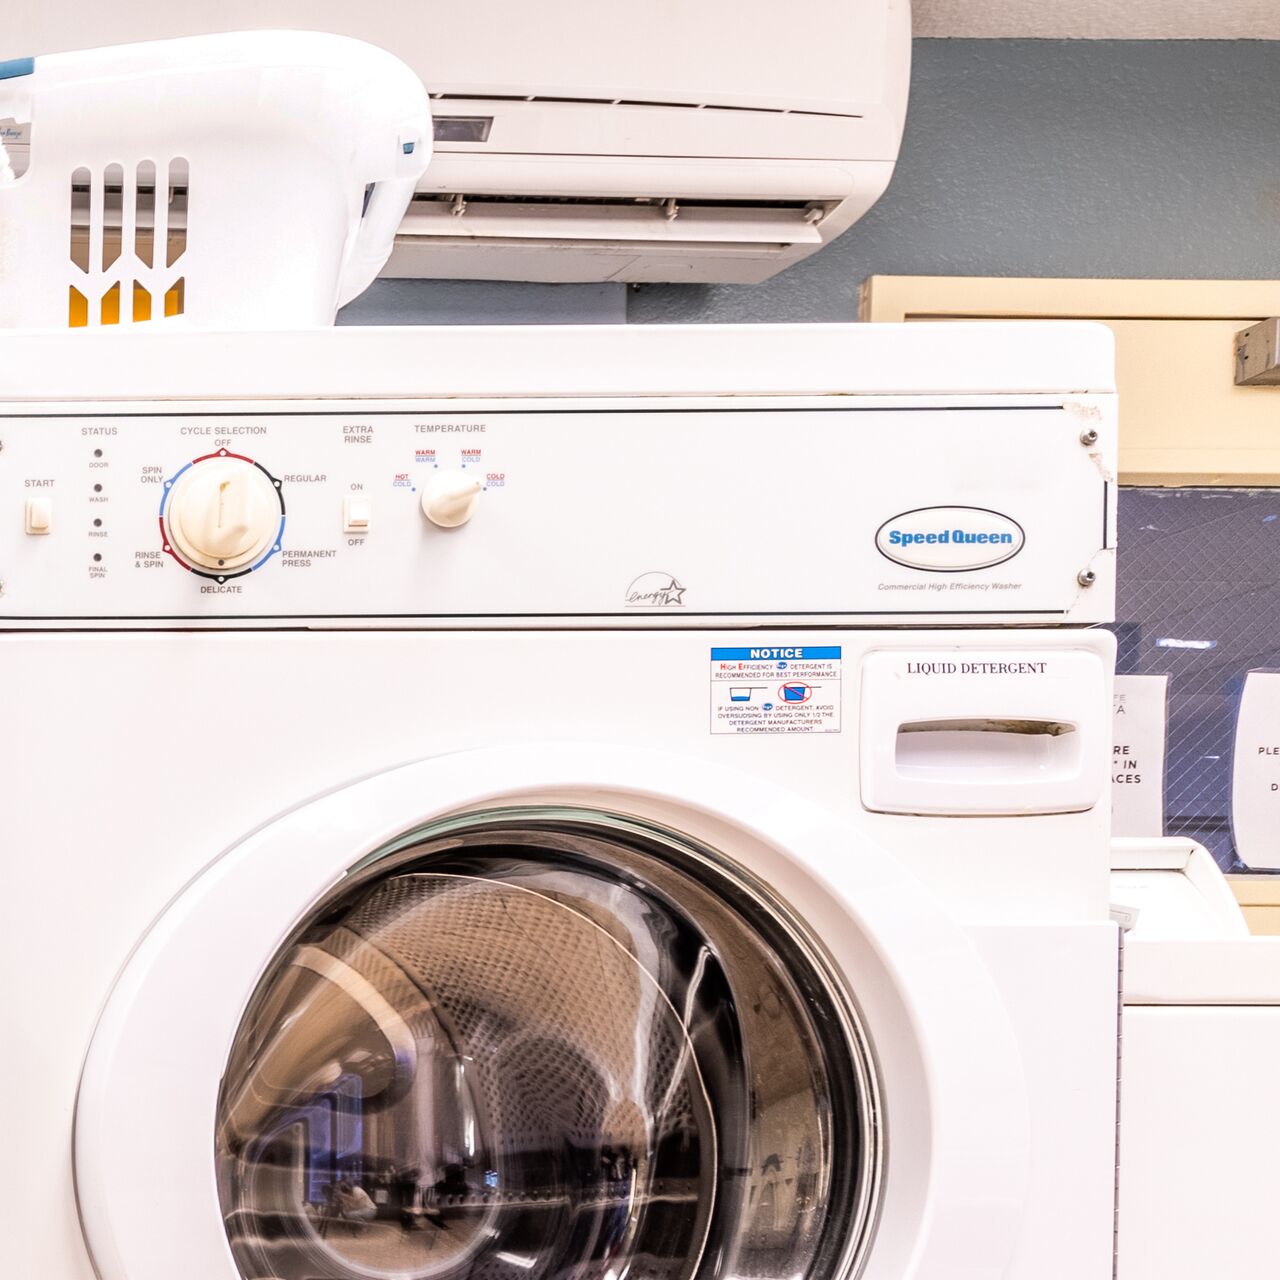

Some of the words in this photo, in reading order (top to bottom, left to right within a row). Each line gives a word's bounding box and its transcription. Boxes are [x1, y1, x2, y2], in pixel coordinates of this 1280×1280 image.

[81, 427, 117, 436] STATUS
[180, 427, 211, 435] CYCLE
[215, 426, 267, 435] SELECTION
[343, 426, 374, 434] EXTRA
[214, 439, 231, 447] OFF
[344, 435, 372, 443] RINSE
[141, 475, 163, 483] ONLY
[350, 483, 363, 491] ON
[348, 538, 364, 546] OFF
[889, 530, 949, 547] Speed
[952, 530, 1012, 544] Queen
[135, 551, 160, 559] RINSE
[282, 550, 336, 558] PERMANENT
[282, 559, 311, 567] PRESS
[200, 586, 241, 594] DELICATE
[928, 583, 947, 592] High
[950, 583, 990, 591] Efficiency
[750, 648, 803, 658] NOTICE
[908, 663, 956, 675] LIQUID
[961, 663, 1047, 673] DETERGENT
[1123, 760, 1137, 769] IN
